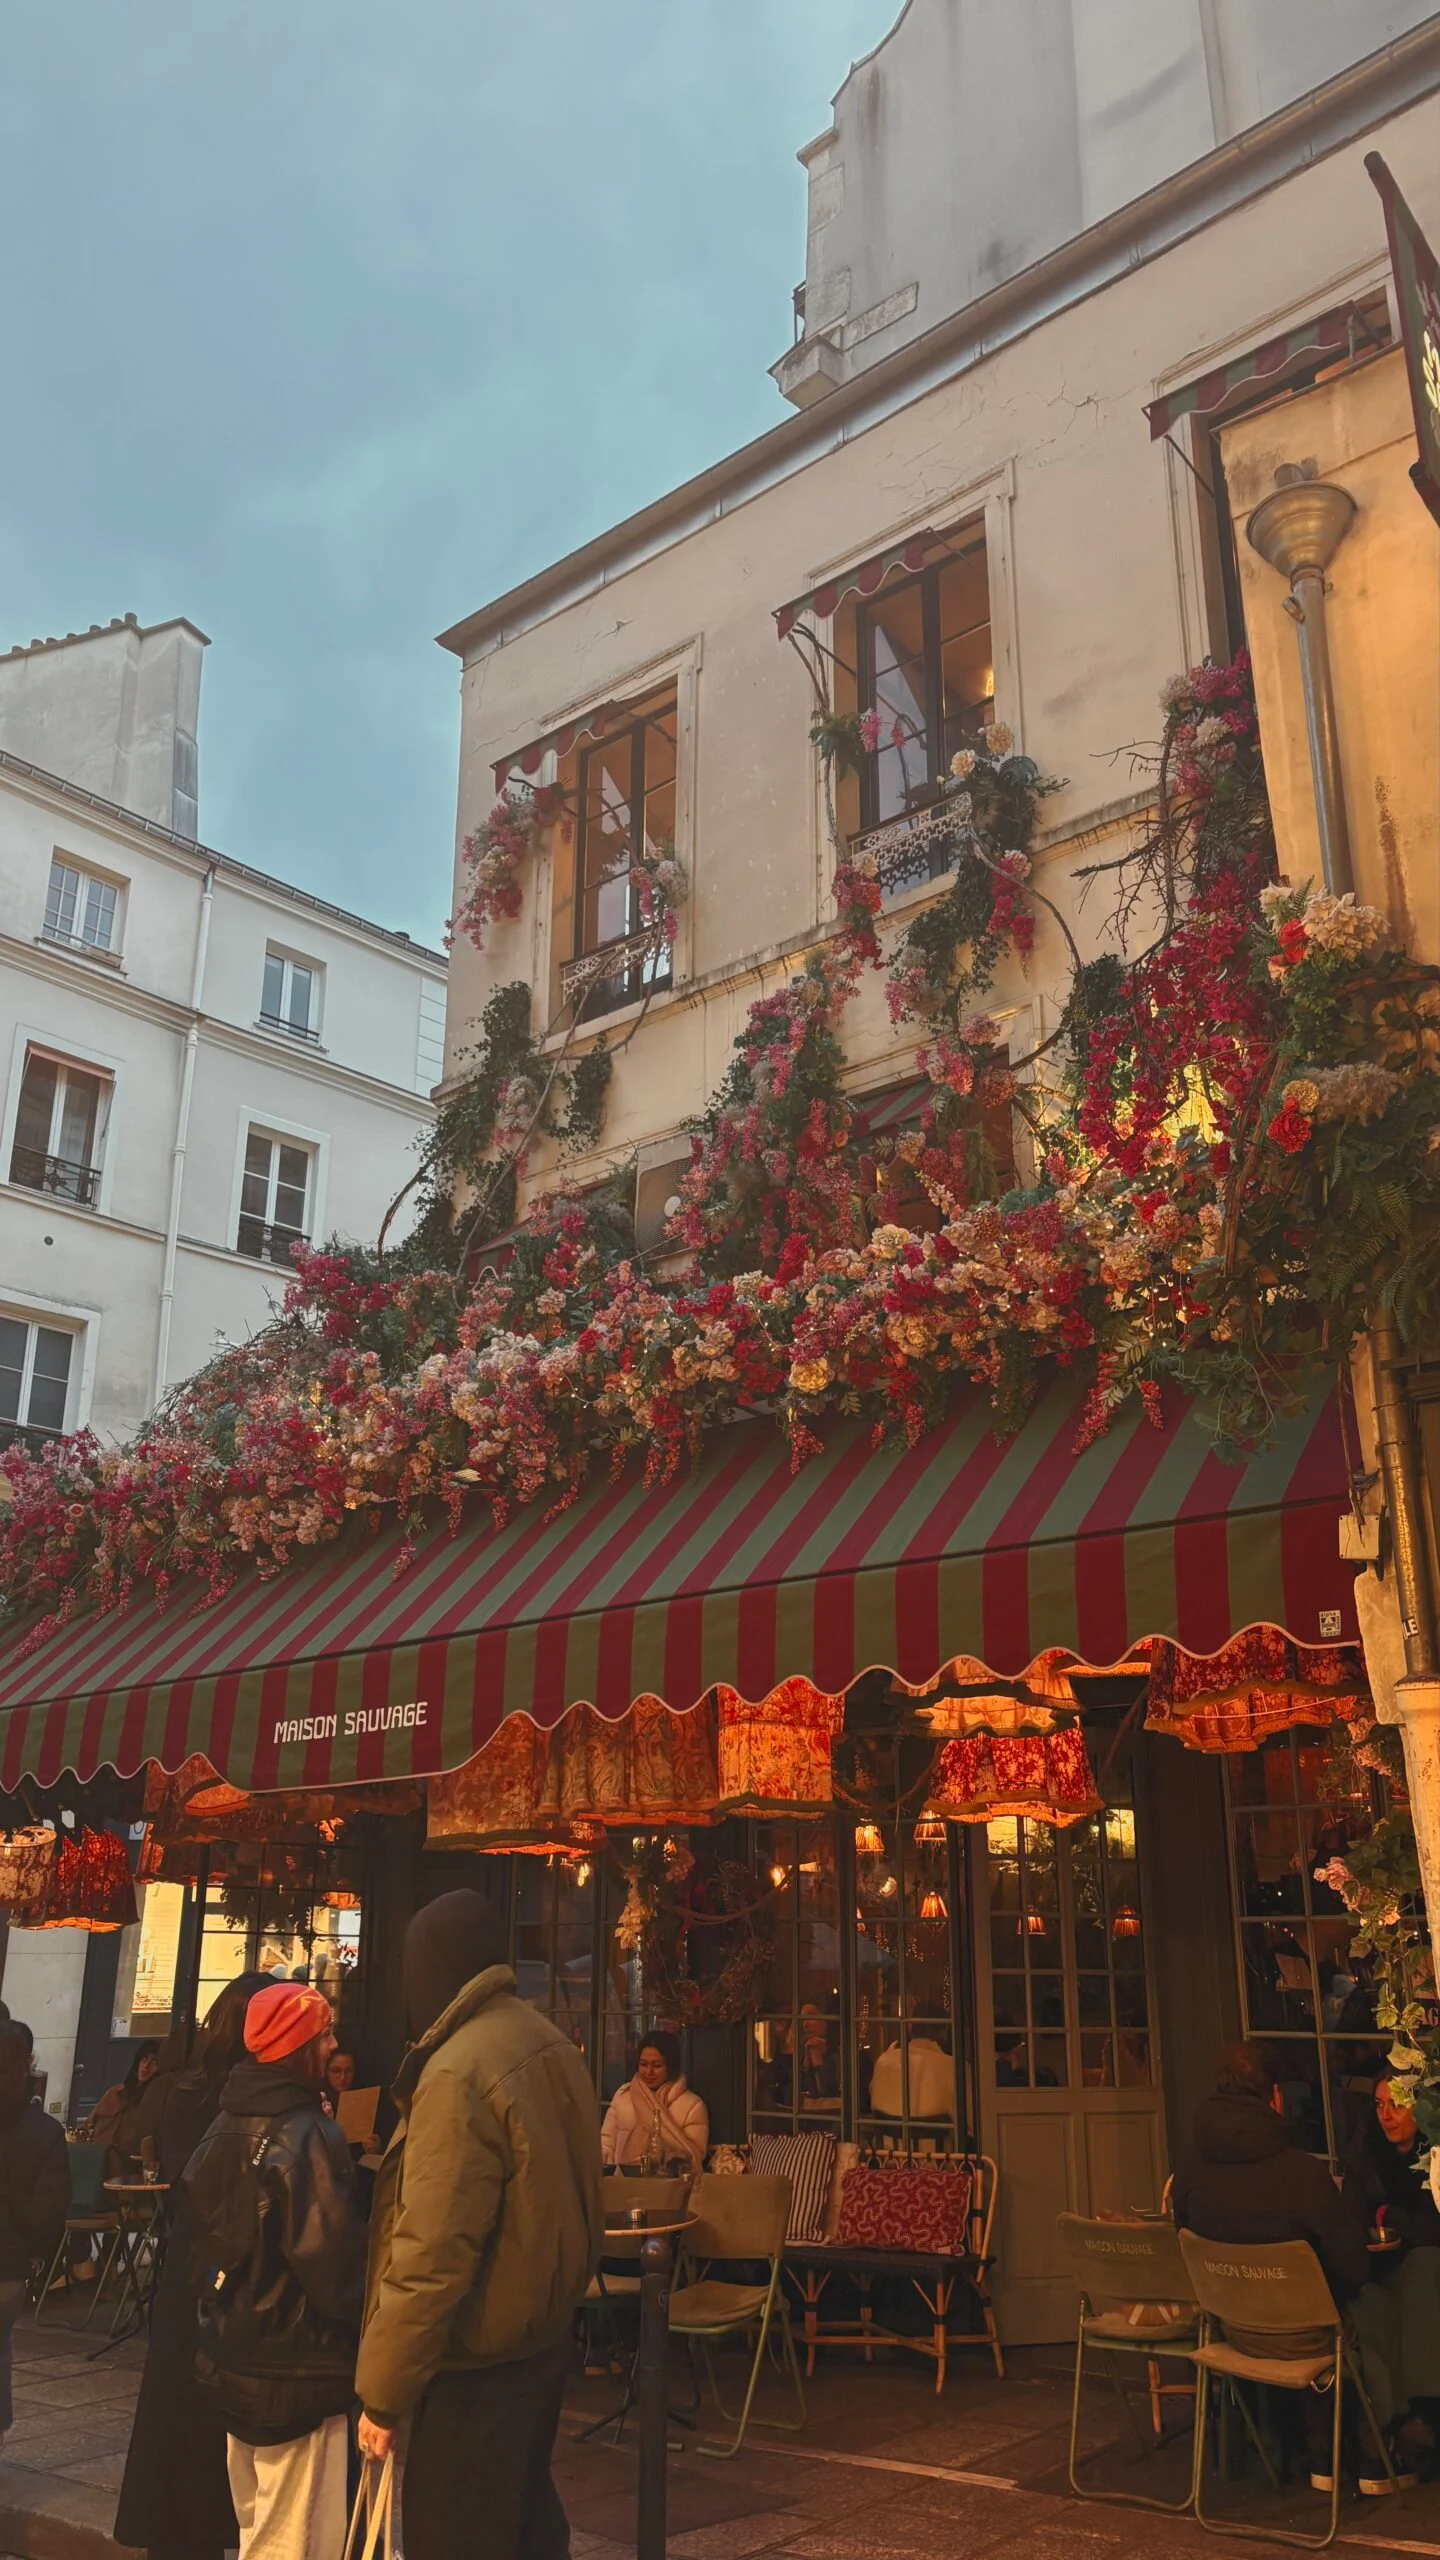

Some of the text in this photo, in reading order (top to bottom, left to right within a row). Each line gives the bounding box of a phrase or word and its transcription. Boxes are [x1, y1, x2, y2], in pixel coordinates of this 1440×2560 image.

[273, 1701, 428, 1744] MAISON SAUVAGE
[1241, 2265, 1288, 2280] SAUVAGE
